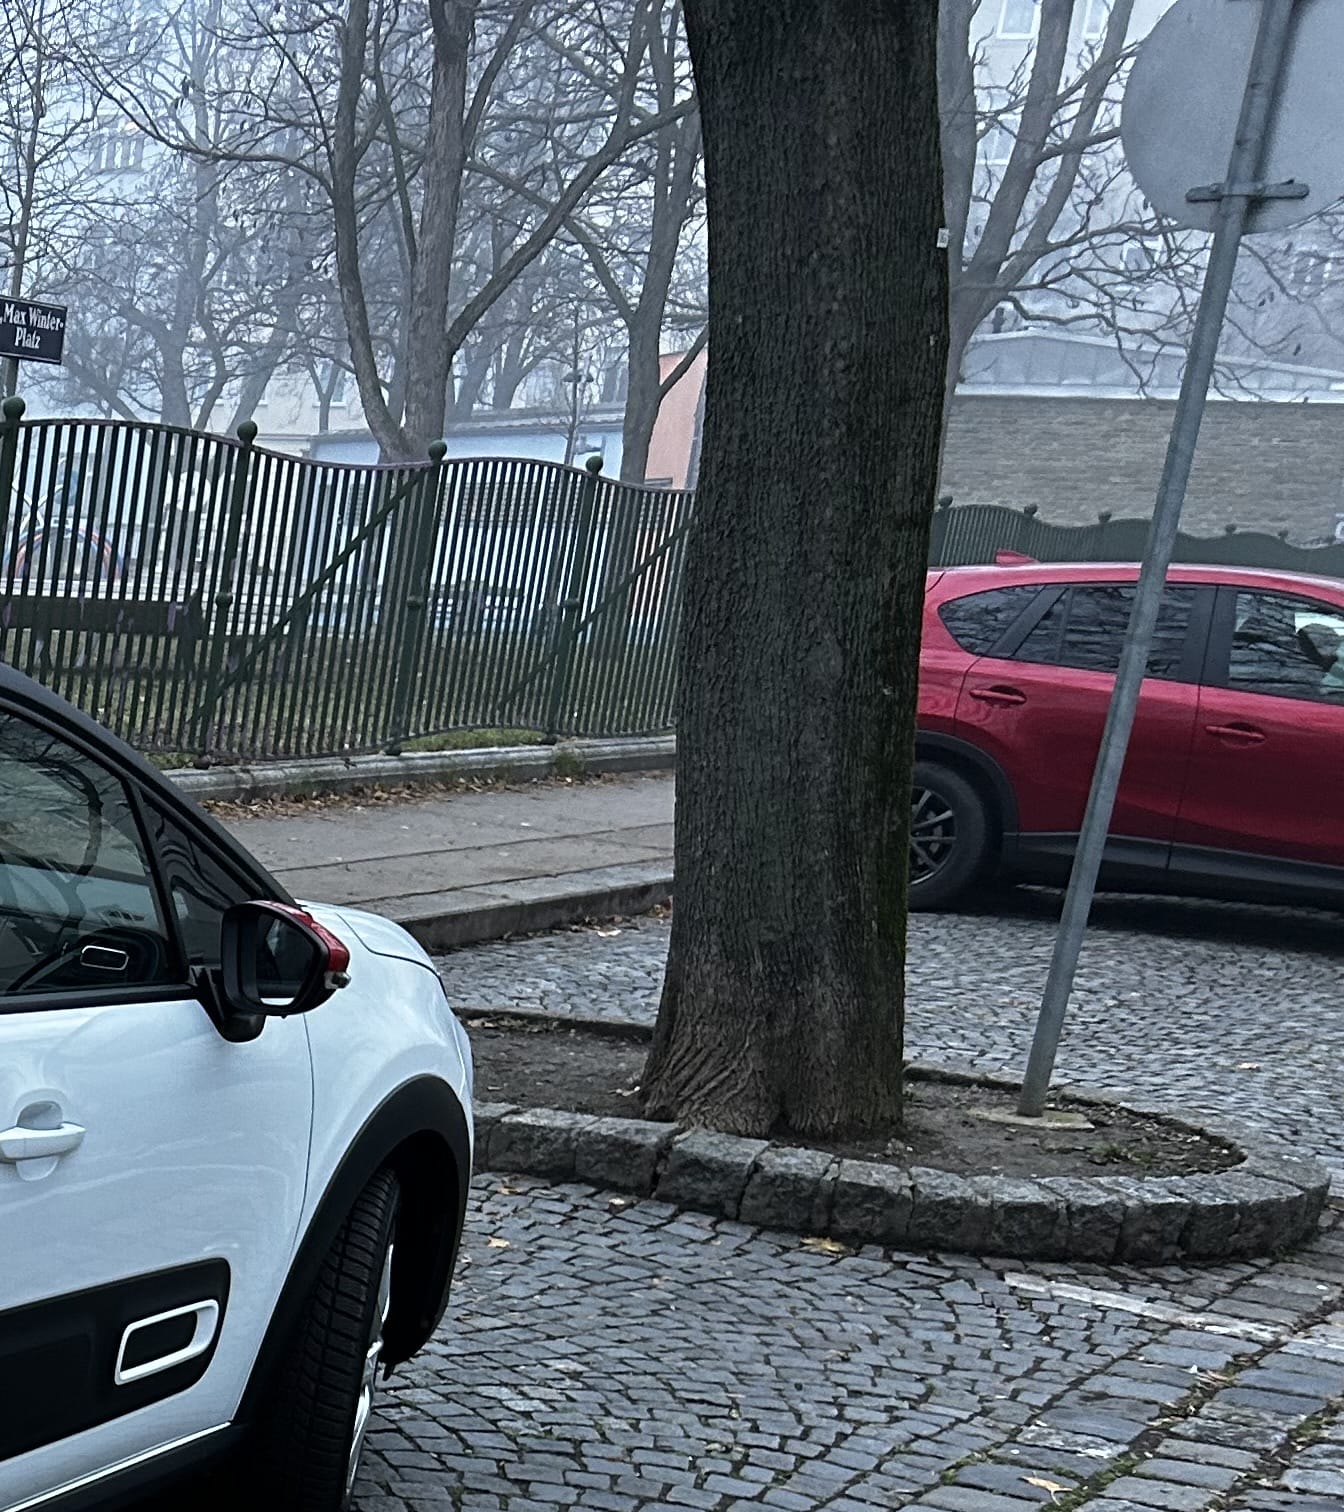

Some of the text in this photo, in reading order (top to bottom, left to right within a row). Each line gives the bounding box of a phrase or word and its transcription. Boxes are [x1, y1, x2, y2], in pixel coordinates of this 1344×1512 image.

[3, 302, 27, 325] Max
[28, 306, 64, 331] Winter-
[14, 326, 41, 349] Platz
